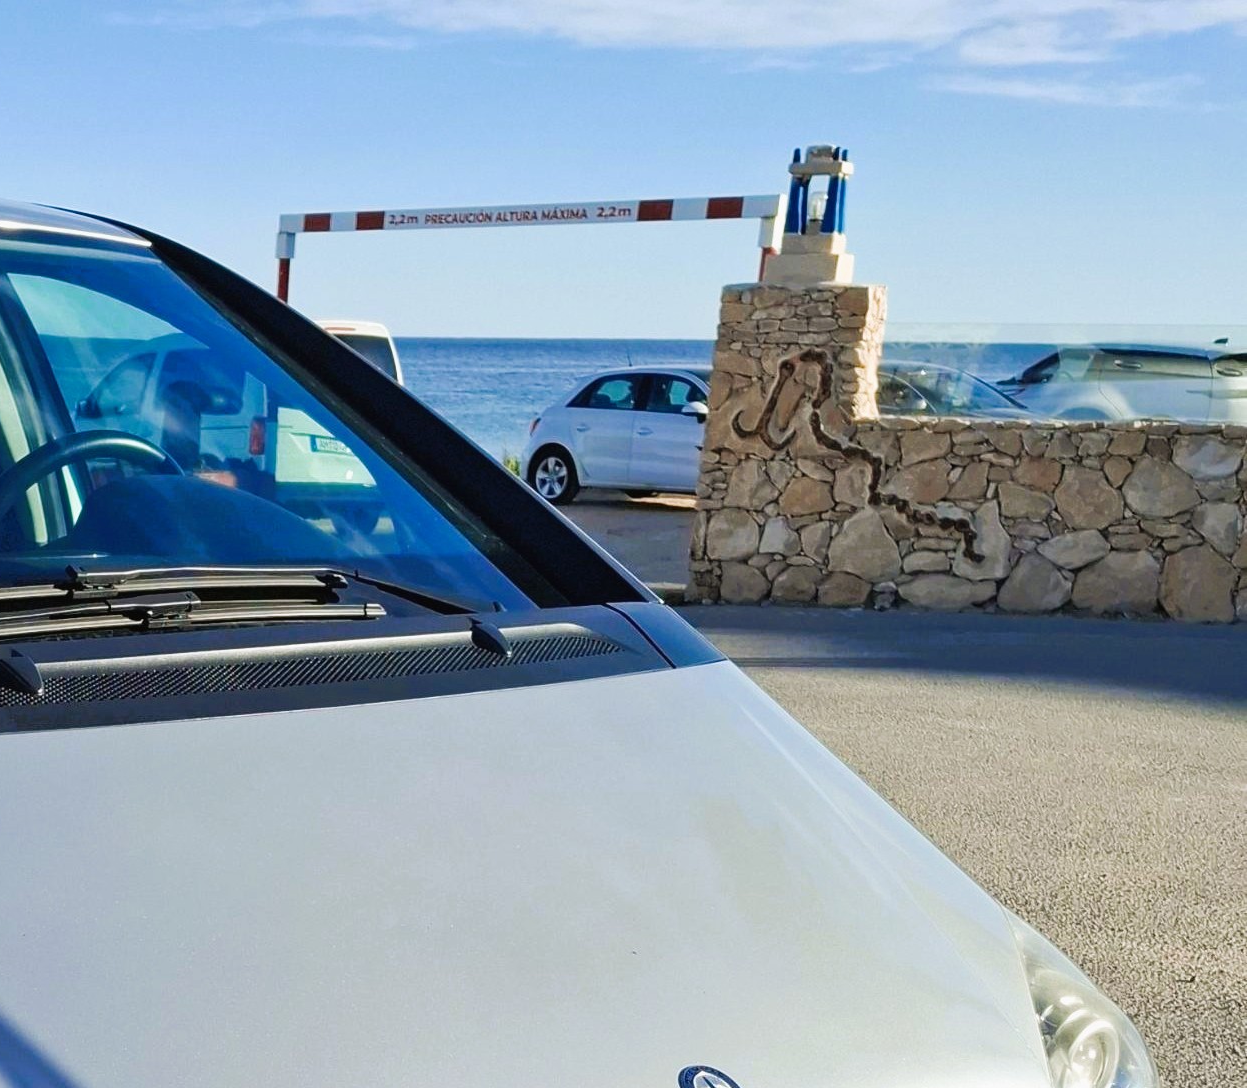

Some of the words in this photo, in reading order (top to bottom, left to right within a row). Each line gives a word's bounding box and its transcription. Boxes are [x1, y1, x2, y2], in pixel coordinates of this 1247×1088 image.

[424, 208, 492, 224] PRECAUCIÓN
[496, 210, 538, 222] ALTURA
[541, 206, 588, 220] MÁXIMA
